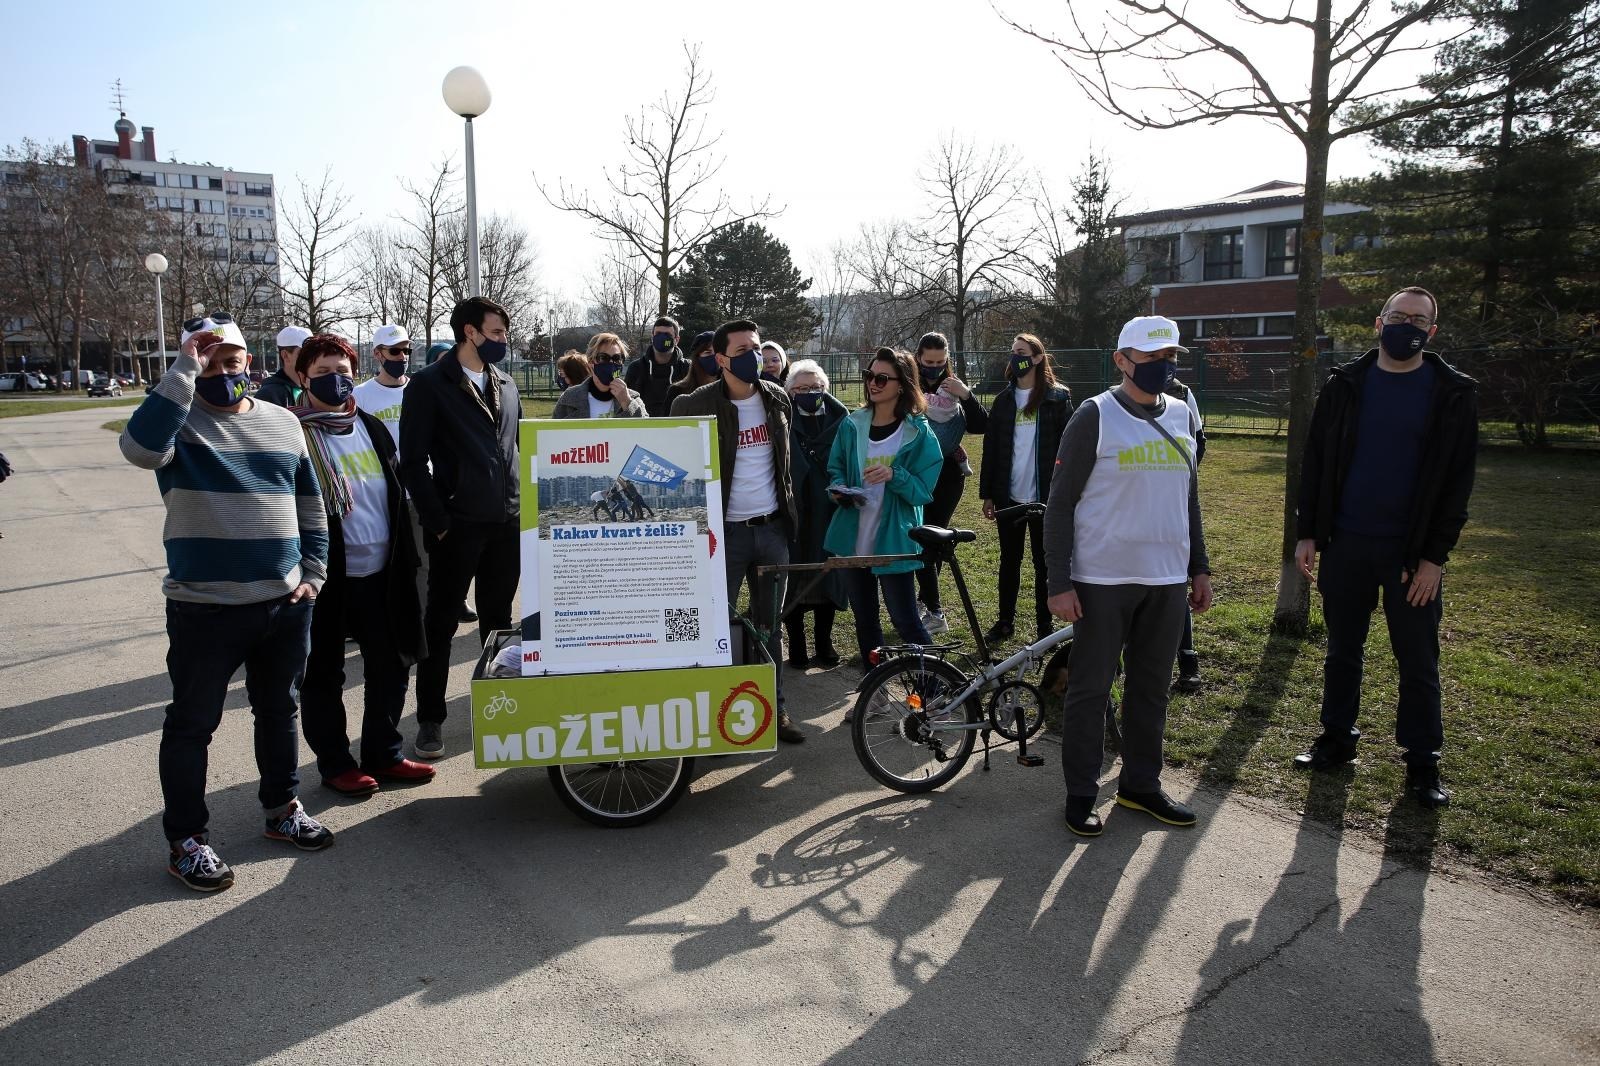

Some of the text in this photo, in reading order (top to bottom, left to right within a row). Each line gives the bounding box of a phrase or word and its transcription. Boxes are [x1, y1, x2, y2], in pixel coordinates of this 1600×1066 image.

[550, 441, 609, 464] MOŽEMO!
[632, 464, 645, 476] je
[640, 455, 676, 478] Zagreb
[553, 523, 685, 540] Kakav kvart želiš?
[554, 610, 588, 618] Pozivamo
[523, 649, 542, 662] MO
[482, 691, 757, 762] MOŽEMO! 3
